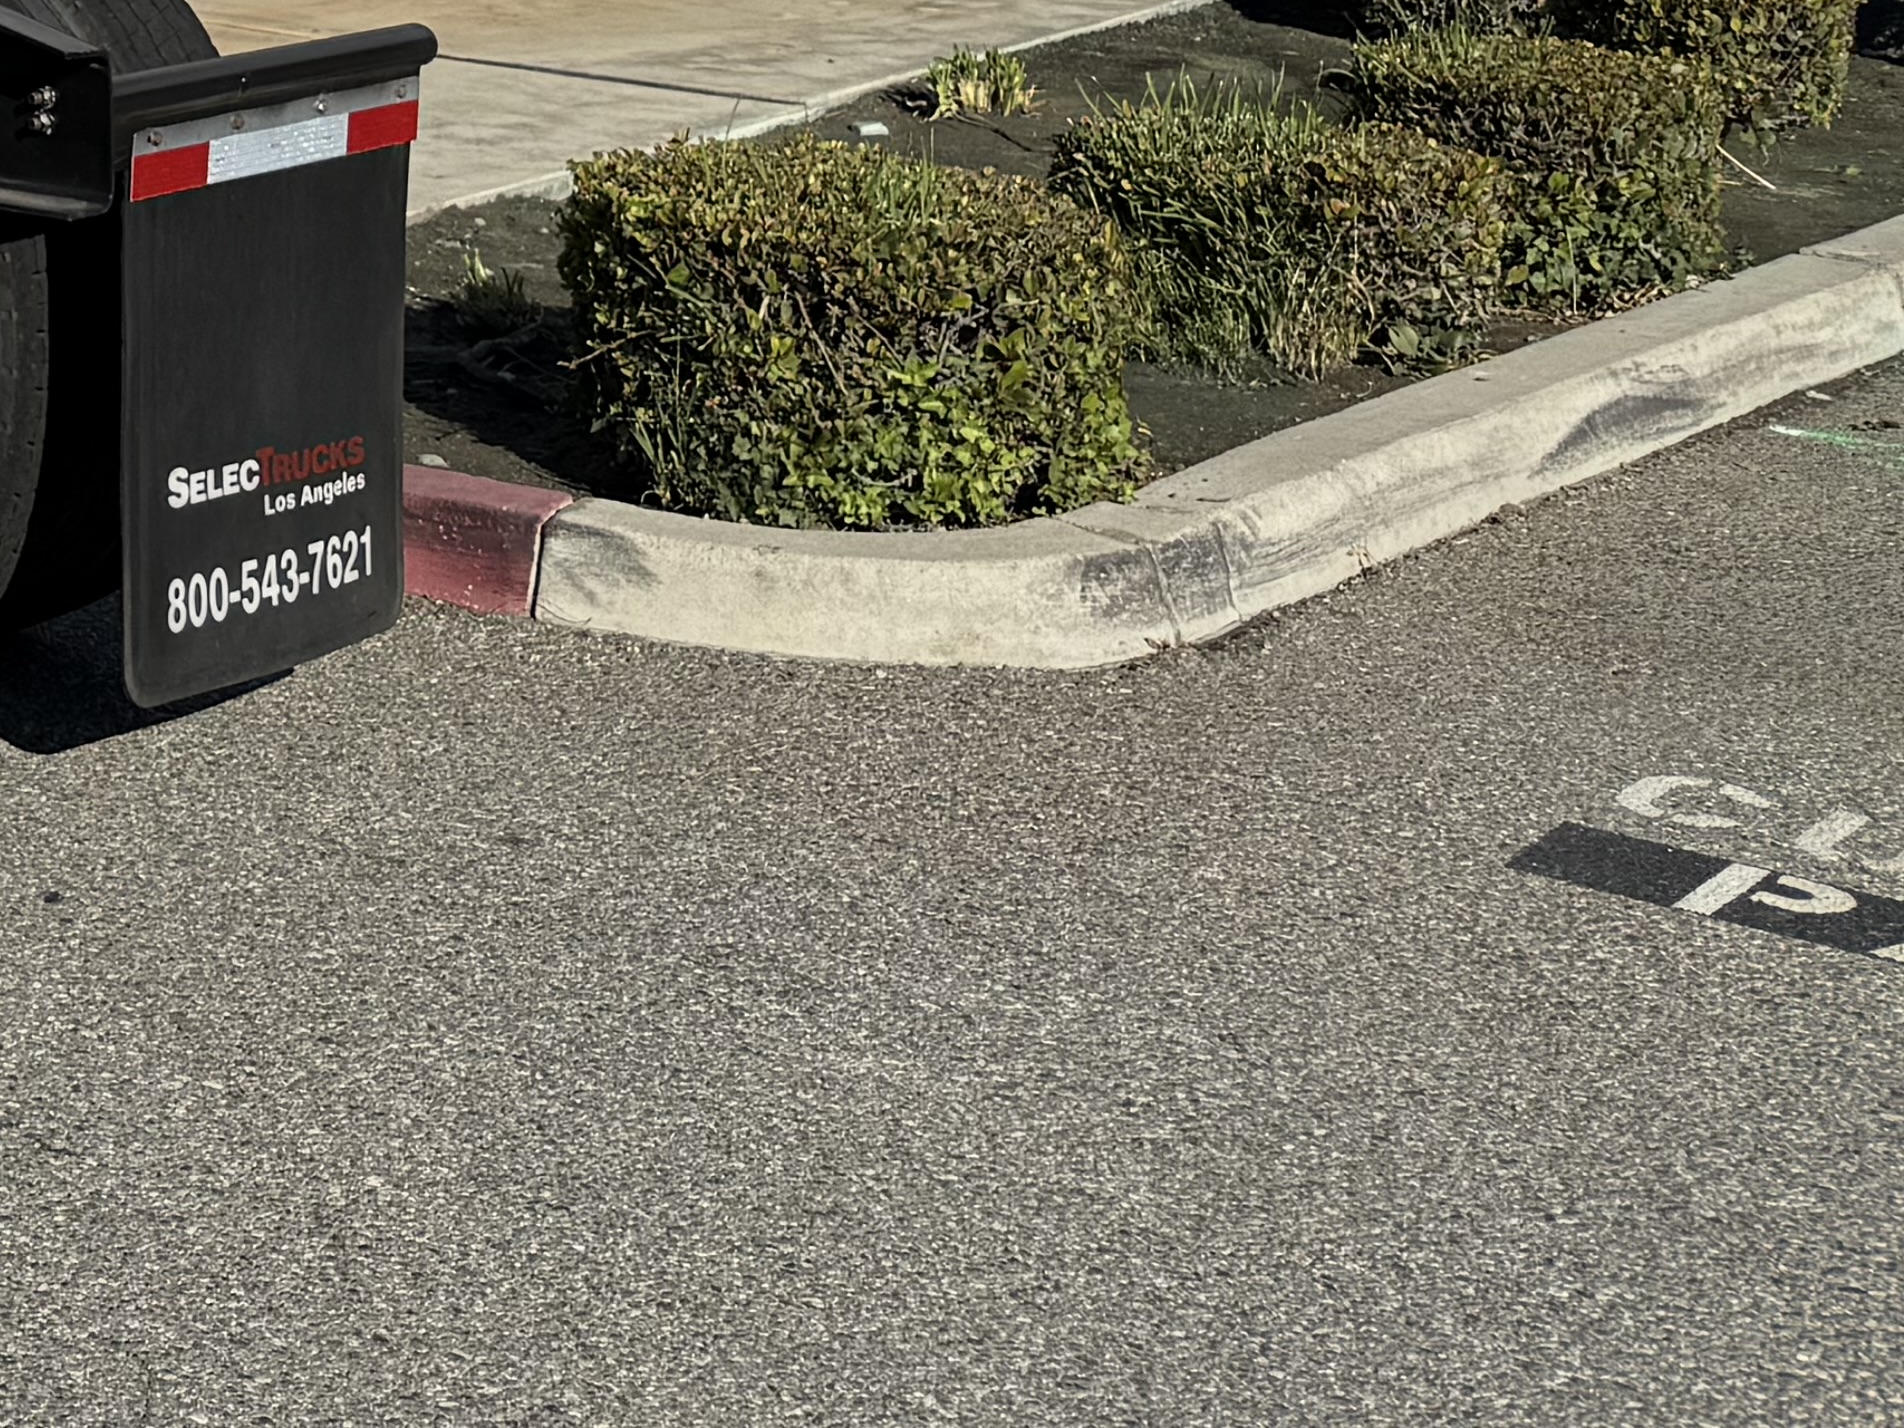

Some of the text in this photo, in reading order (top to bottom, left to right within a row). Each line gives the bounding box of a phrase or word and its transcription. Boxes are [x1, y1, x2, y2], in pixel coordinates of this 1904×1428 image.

[167, 435, 366, 509] SELECTRUCKS
[263, 471, 366, 516] Los Angeles
[167, 524, 373, 634] 800-543-7621
